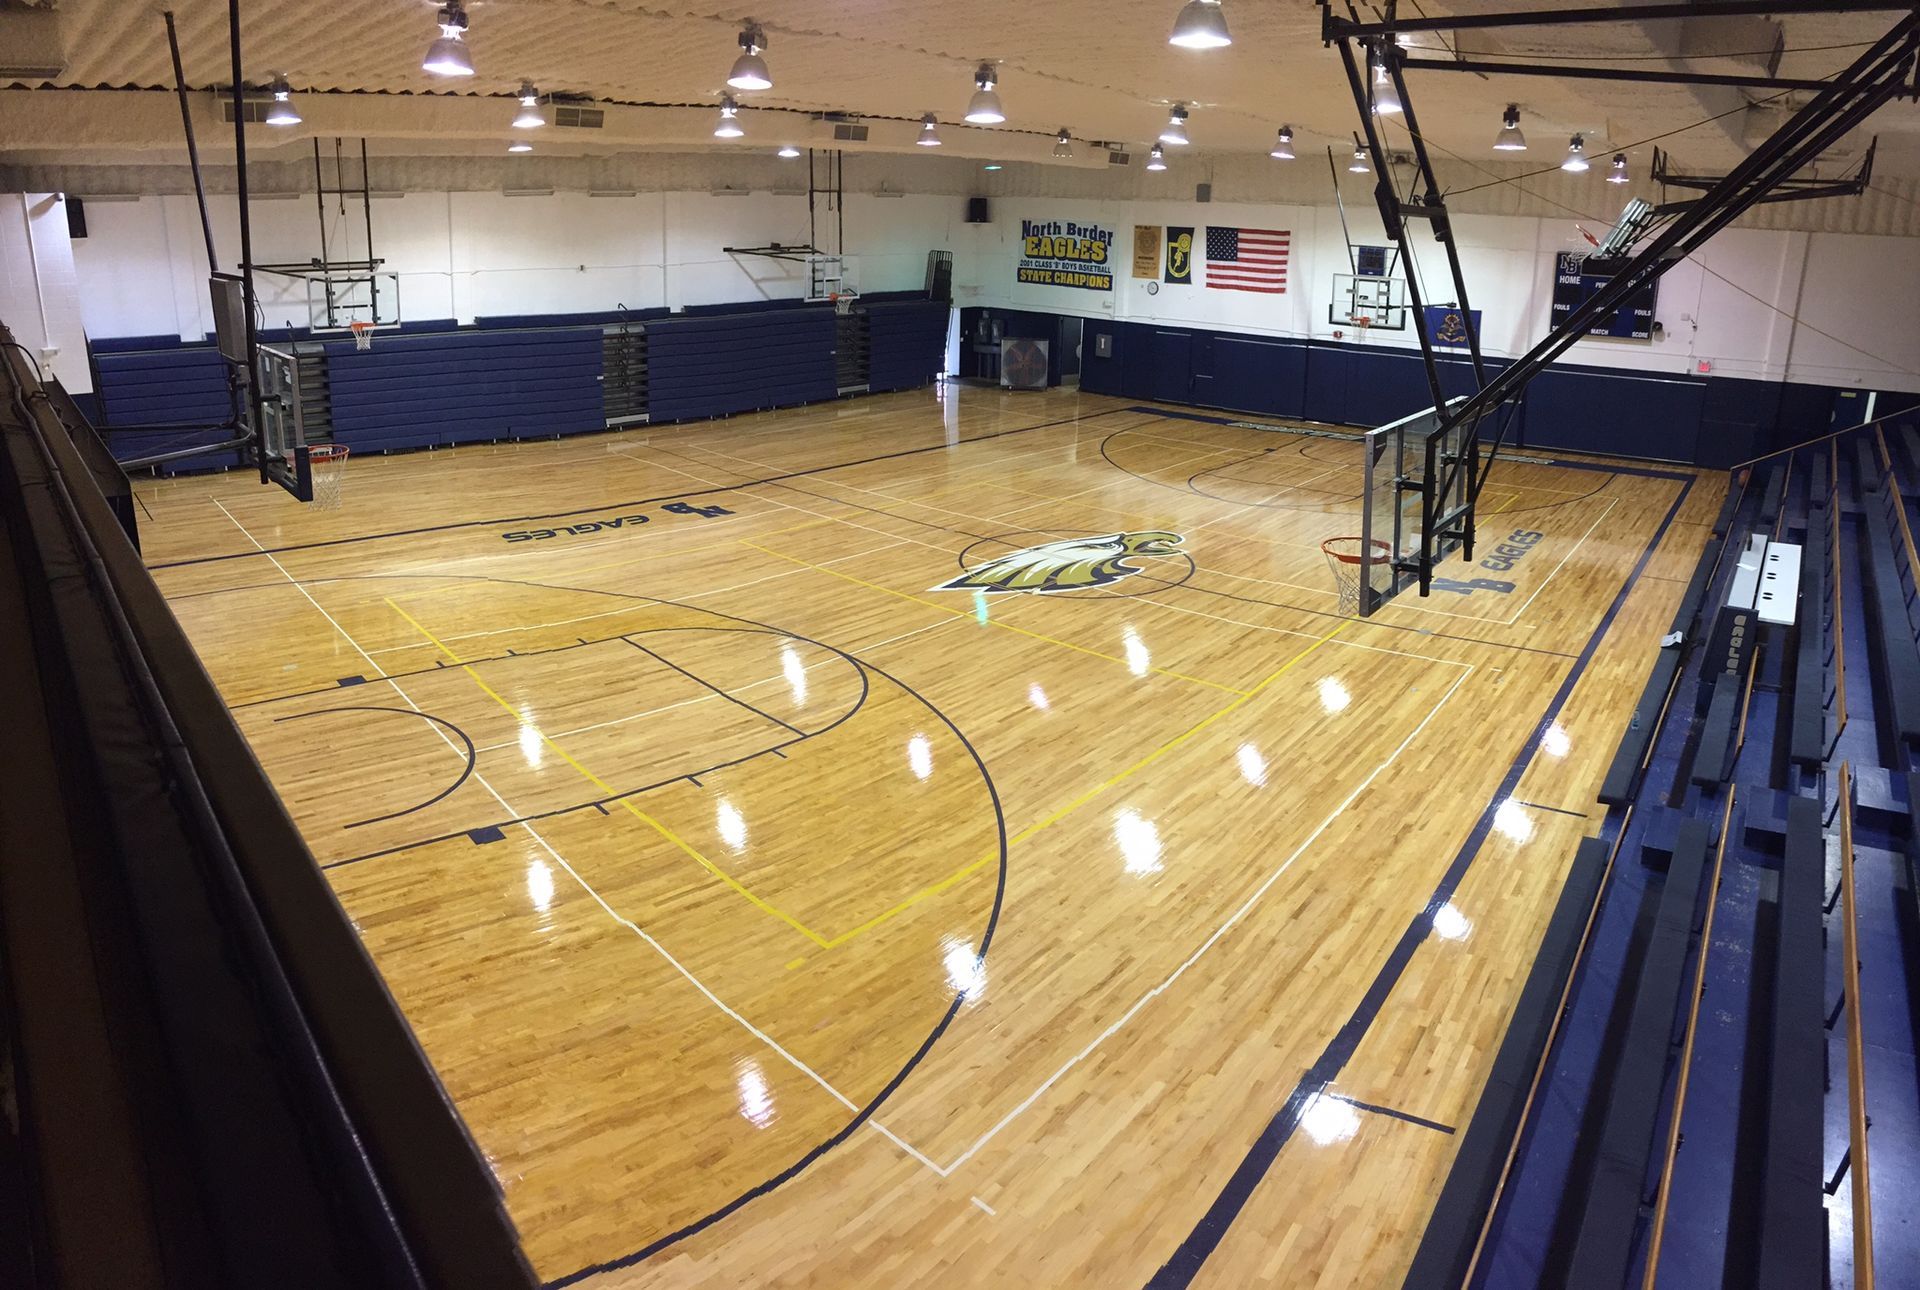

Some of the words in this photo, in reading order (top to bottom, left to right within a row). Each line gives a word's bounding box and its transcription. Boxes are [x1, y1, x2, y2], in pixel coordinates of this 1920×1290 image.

[1022, 220, 1061, 240] North
[1067, 223, 1113, 246] Border
[1025, 236, 1107, 264] EAGLES
[1035, 260, 1052, 268] CLASS
[1062, 262, 1077, 271] BOYS
[1020, 269, 1052, 282] STATE
[1054, 272, 1110, 289] CHAMPIONS
[1559, 275, 1581, 285] HOME
[502, 514, 650, 543] EAGLES
[1480, 528, 1544, 571] EAGLES
